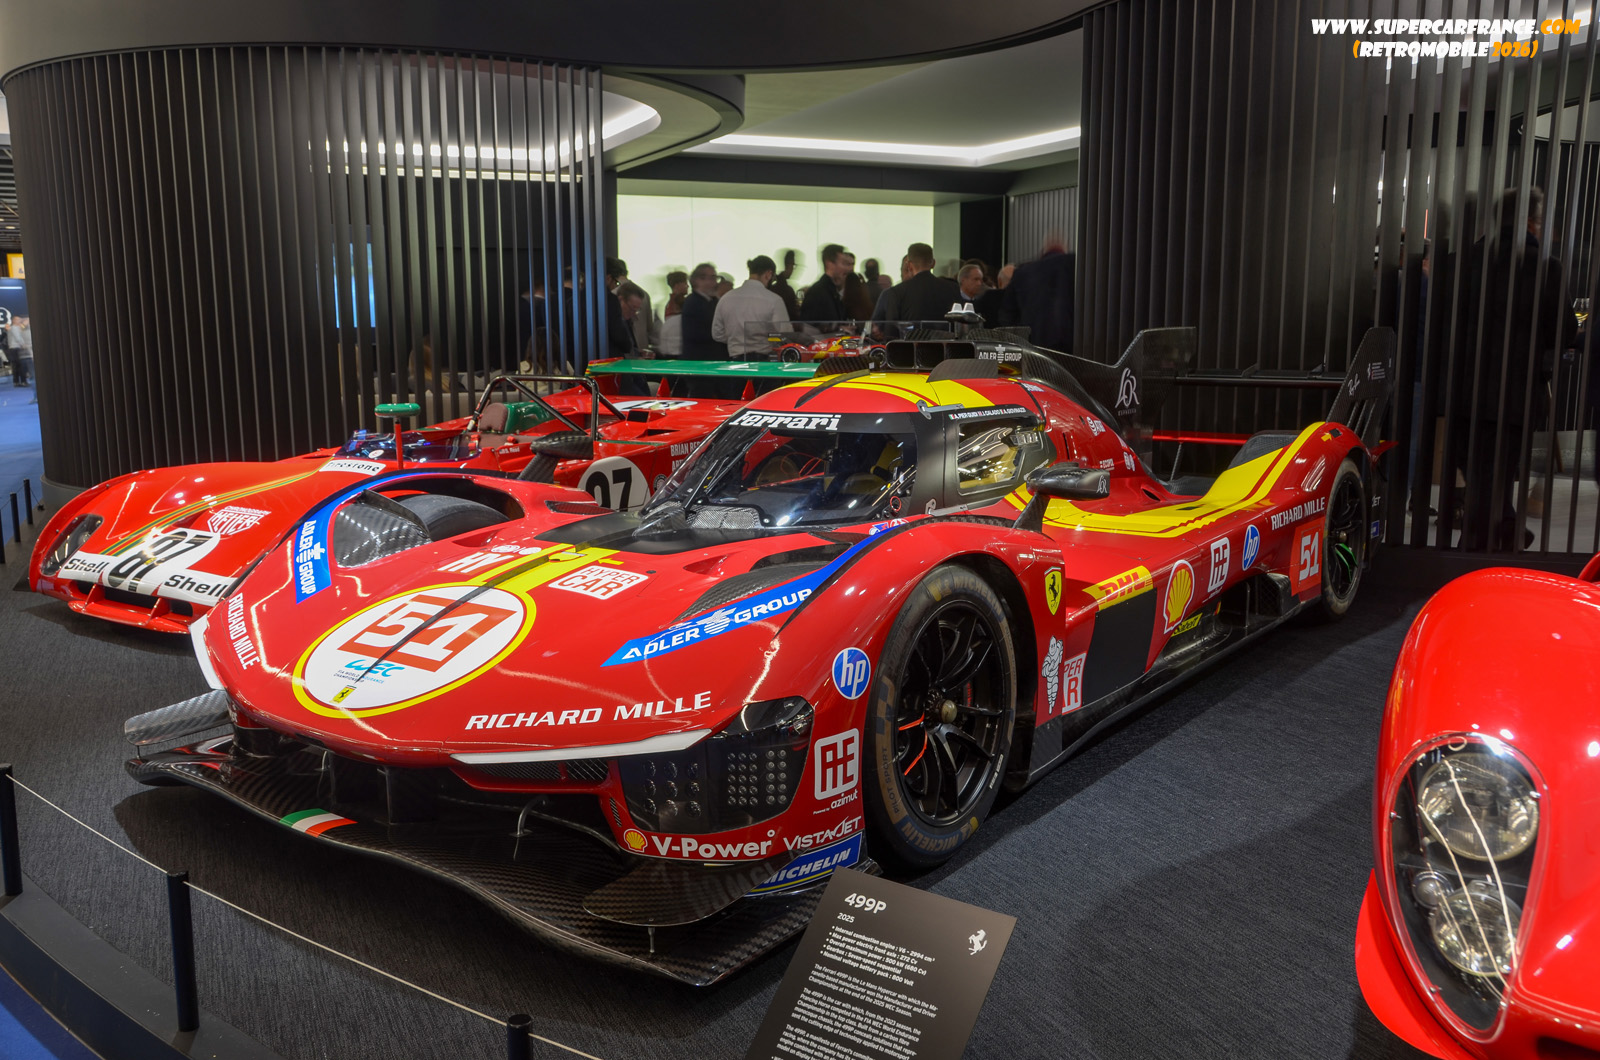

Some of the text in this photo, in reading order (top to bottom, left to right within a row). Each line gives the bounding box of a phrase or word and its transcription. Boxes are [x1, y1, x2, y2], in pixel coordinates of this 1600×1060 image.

[1005, 353, 1022, 361] GROUP
[729, 411, 842, 431] Ferrari
[670, 443, 689, 457] BRIAN
[1271, 497, 1325, 530] RICHARD MILLE
[299, 520, 317, 595] ADLER GROUP
[1299, 532, 1319, 581] 51
[64, 558, 229, 598] Shell Shell
[557, 575, 623, 596] CAR
[582, 566, 641, 584] HYPER
[1099, 571, 1146, 602] DHL
[227, 592, 260, 670] RICHARD MILLE
[353, 600, 489, 662] 51
[621, 588, 812, 660] ADLER GROUP
[840, 647, 867, 698] hp
[464, 690, 711, 730] RICHARD MILLE
[651, 835, 772, 859] V-Power
[837, 912, 855, 923] 2025
[844, 892, 887, 914] 499P
